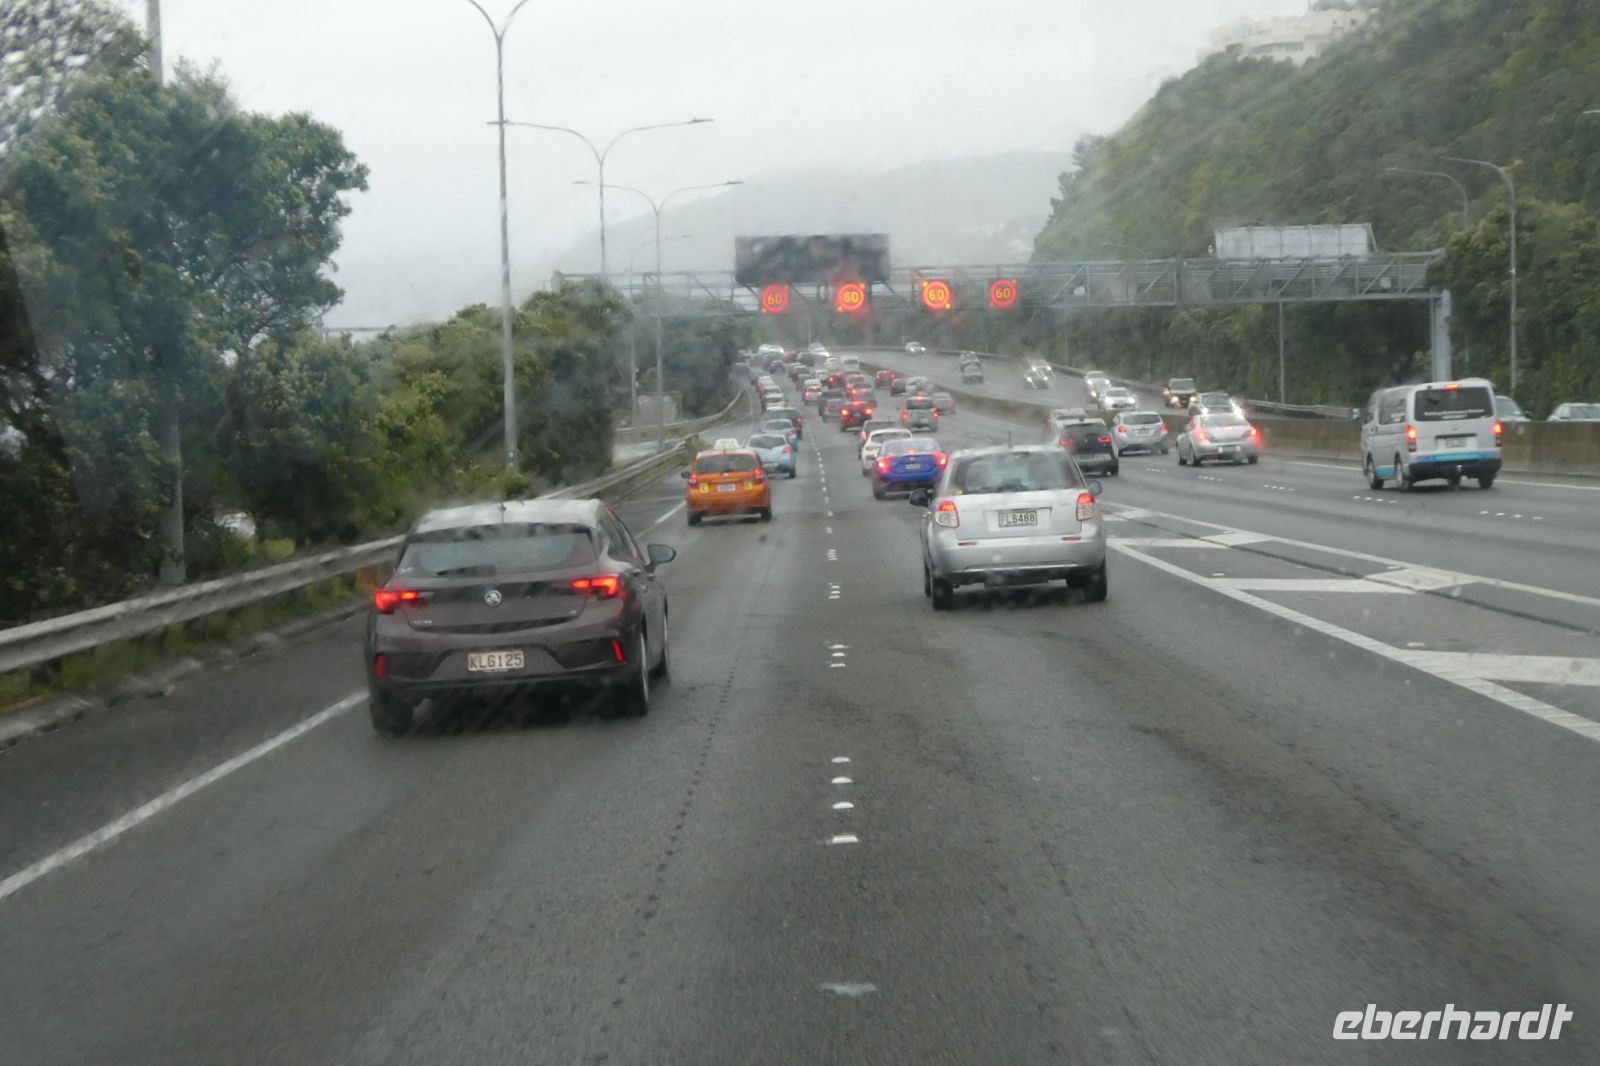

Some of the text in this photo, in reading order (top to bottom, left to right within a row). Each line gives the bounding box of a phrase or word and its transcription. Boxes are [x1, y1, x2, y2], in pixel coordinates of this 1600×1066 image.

[767, 293, 783, 305] 60
[843, 291, 859, 304] 60
[928, 288, 945, 301] 60
[995, 287, 1011, 299] 60
[469, 653, 523, 669] KLG125
